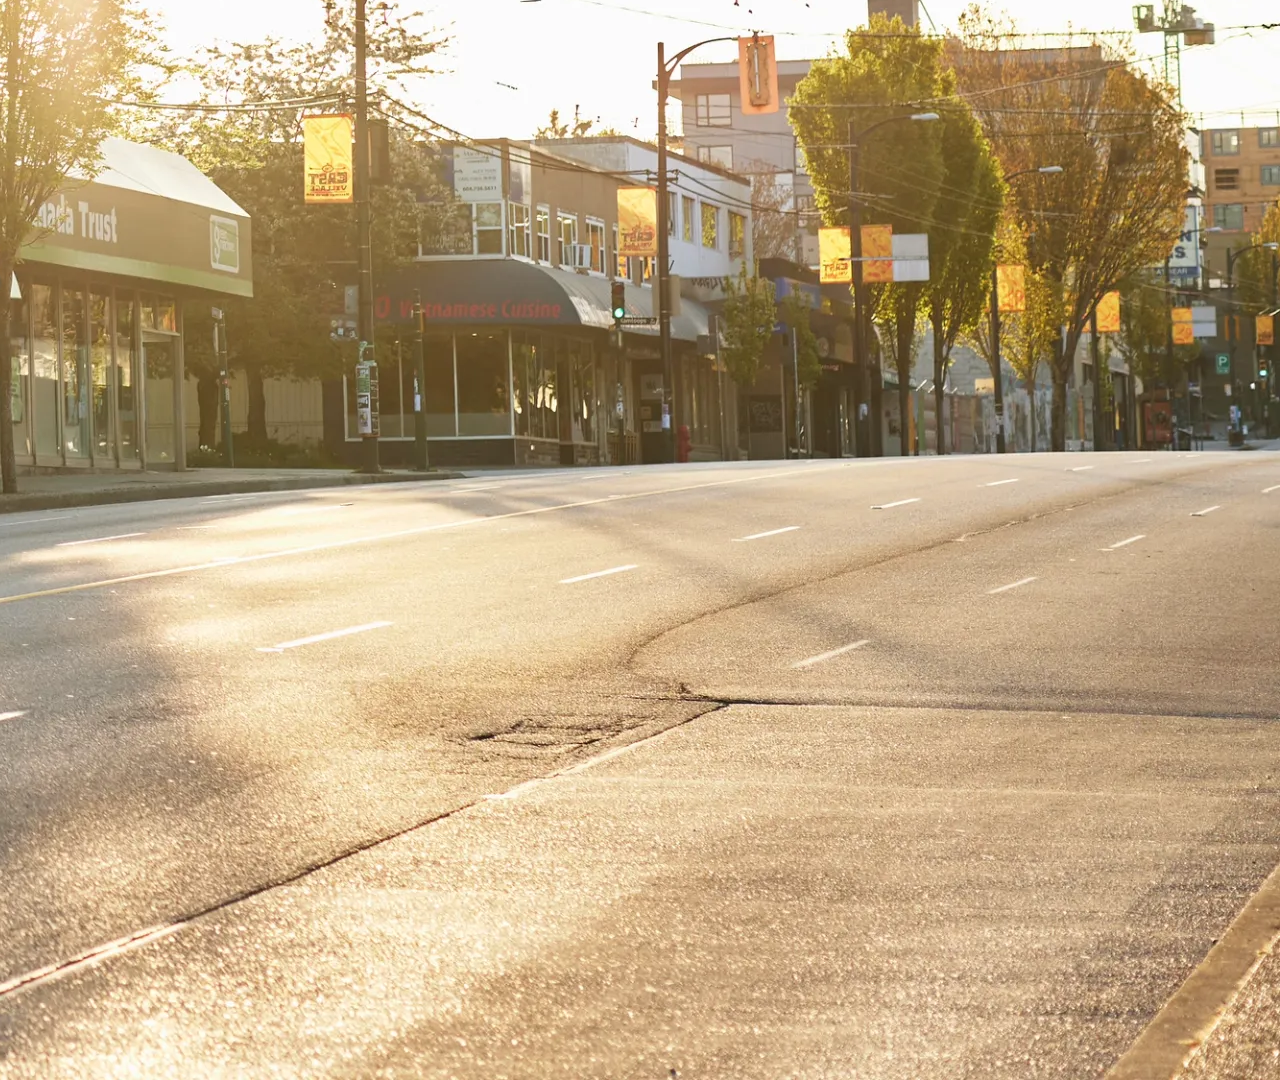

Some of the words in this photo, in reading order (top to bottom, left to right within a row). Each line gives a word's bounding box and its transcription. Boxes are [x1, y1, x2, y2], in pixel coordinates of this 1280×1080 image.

[78, 201, 118, 243] Trust
[501, 299, 561, 318] Cuisine
[1218, 355, 1228, 366] P
